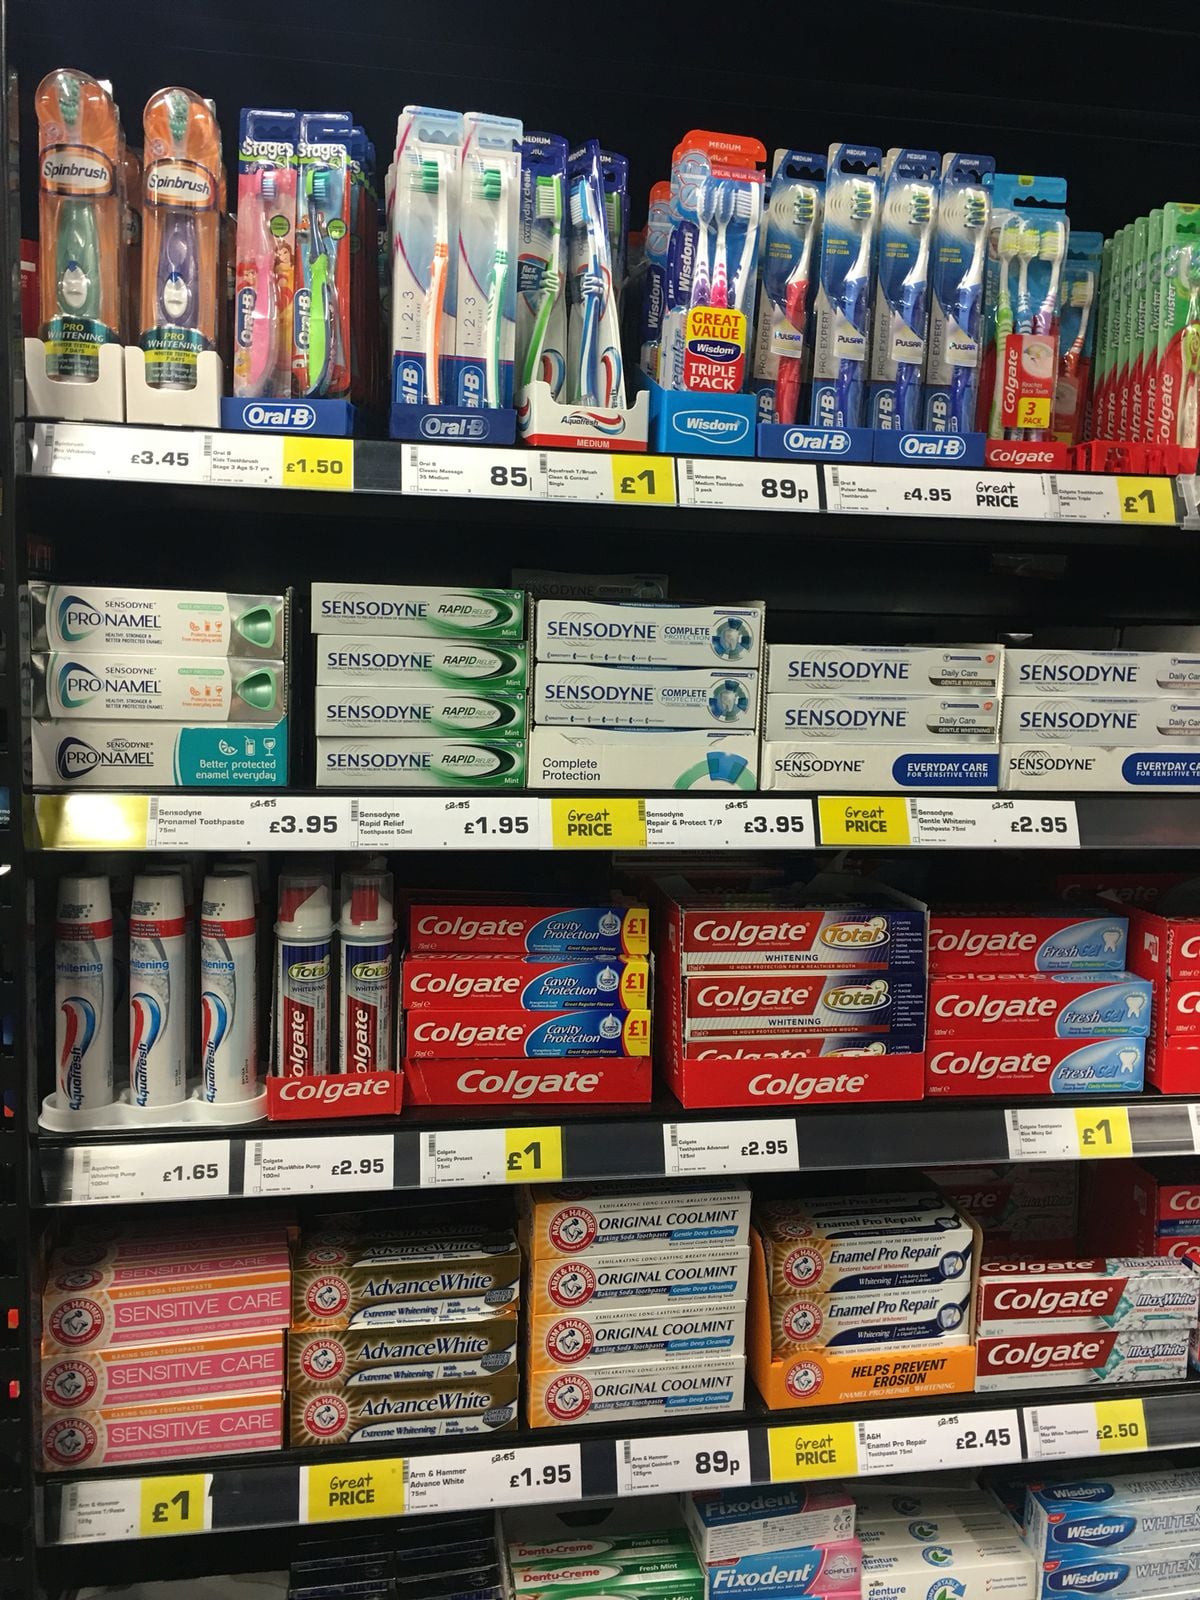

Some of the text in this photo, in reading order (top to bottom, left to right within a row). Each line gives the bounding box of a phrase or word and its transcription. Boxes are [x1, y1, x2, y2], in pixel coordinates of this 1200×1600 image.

[242, 140, 293, 158] Stages
[709, 141, 741, 151] MEDIUM
[43, 161, 108, 181] Spinbrush
[149, 174, 209, 195] Spinbrush
[678, 231, 693, 292] Wisdom
[1164, 285, 1175, 329] Twister
[692, 312, 741, 327] GREAT
[62, 323, 84, 332] PRO
[692, 326, 739, 339] VALUE
[48, 331, 104, 343] WHITENING
[837, 335, 864, 344] PULSAR
[148, 339, 202, 351] WHITENING
[697, 344, 735, 356] Wisdom
[690, 363, 736, 378] TRIPLE
[690, 376, 734, 391] PACK
[1004, 348, 1018, 414] Colgate
[248, 407, 310, 425] Oral-B
[1025, 402, 1036, 415] 3
[426, 417, 484, 436] Oral-B
[560, 416, 598, 426] Aquafresh
[687, 417, 738, 431] Wisdom
[576, 439, 610, 448] MEDIUM
[904, 438, 959, 455] Oral-B
[131, 451, 190, 467] £3.45
[990, 449, 1054, 463] Colgate
[286, 458, 343, 474] £1.50
[620, 470, 656, 494] £1
[976, 482, 1015, 493] Great
[761, 478, 808, 502] 89p
[904, 488, 951, 501] £4.95
[977, 495, 1019, 507] PRICE
[1124, 490, 1155, 513] £1
[105, 601, 154, 609] SENSODYNE
[321, 600, 427, 617] SENSODYNE
[438, 605, 473, 615] RAPID
[68, 612, 162, 628] PRONAMEL
[547, 621, 656, 639] SENSODYNE
[664, 626, 710, 636] COMPLETE
[443, 655, 477, 665] RAPID
[788, 661, 908, 679] SENSODYNE
[942, 669, 978, 677] Daily Care
[327, 705, 431, 720] SENSODYNE
[200, 760, 276, 770] Better protected
[542, 758, 598, 769] Complete
[775, 760, 862, 772] SENSODYNE
[907, 763, 988, 771] EVERYDAY CARE
[196, 770, 276, 781] enamel everyday
[542, 770, 601, 781] Protection
[360, 811, 400, 819] Sensodyne
[568, 809, 610, 822] Great
[845, 806, 884, 818] Great
[159, 818, 244, 826] Pronamel Toothpaste
[269, 816, 338, 833] £3.95
[360, 820, 381, 828] Rapid
[464, 816, 529, 834] £1.95
[744, 816, 804, 833] £3.95
[846, 820, 887, 832] PRICE
[1011, 816, 1067, 833] £2.95
[568, 824, 612, 836] PRICE
[417, 916, 524, 940] Colgate
[547, 921, 581, 930] Cavity
[628, 919, 646, 934] £1
[543, 930, 600, 940] Protection
[830, 927, 880, 942] Total
[929, 929, 1036, 956] Colgate
[626, 973, 644, 989] £1
[697, 985, 809, 1012] Colgate
[832, 990, 882, 1005] Total
[935, 995, 1057, 1022] Colgate
[413, 1022, 523, 1047] Colgate
[70, 1047, 83, 1110] Aquafresh
[137, 1044, 148, 1107] Aquafresh
[457, 1070, 599, 1099] Colgate
[1083, 1119, 1112, 1145] £1
[741, 1140, 788, 1156] £2.95
[508, 1142, 542, 1171] £1
[163, 1163, 219, 1181] £1.65
[331, 1159, 384, 1175] £2.95
[599, 1210, 739, 1230] ORIGINAL COOLMINT
[829, 1245, 941, 1264] Enamel Pro Repair
[360, 1274, 492, 1297] AdvanceWhite
[119, 1292, 282, 1322] SENSITIVE CARE
[994, 1288, 1108, 1314] Colgate
[363, 1306, 438, 1318] Extreme Whitening
[112, 1353, 275, 1385] SENSITIVE CARE
[851, 1359, 947, 1378] HELPS PREVENT
[874, 1373, 926, 1387] EROSION
[956, 1428, 1011, 1450] £2.45
[1096, 1423, 1139, 1440] £2.50
[795, 1436, 833, 1450] Great
[867, 1440, 893, 1448] Enamel
[907, 1438, 927, 1446] Repair
[695, 1451, 740, 1476] 89p
[796, 1450, 837, 1465] PRICE
[437, 1468, 467, 1476] Hammer
[510, 1465, 572, 1488] £1.95
[330, 1476, 373, 1490] Great
[410, 1477, 465, 1488] Advance White
[329, 1490, 375, 1506] PRICE
[1053, 1487, 1105, 1498] Wisdom
[153, 1490, 190, 1522] £1
[519, 1543, 593, 1557] Dentu-Creme
[713, 1567, 811, 1588] Fixodent
[869, 1586, 906, 1596] denture
